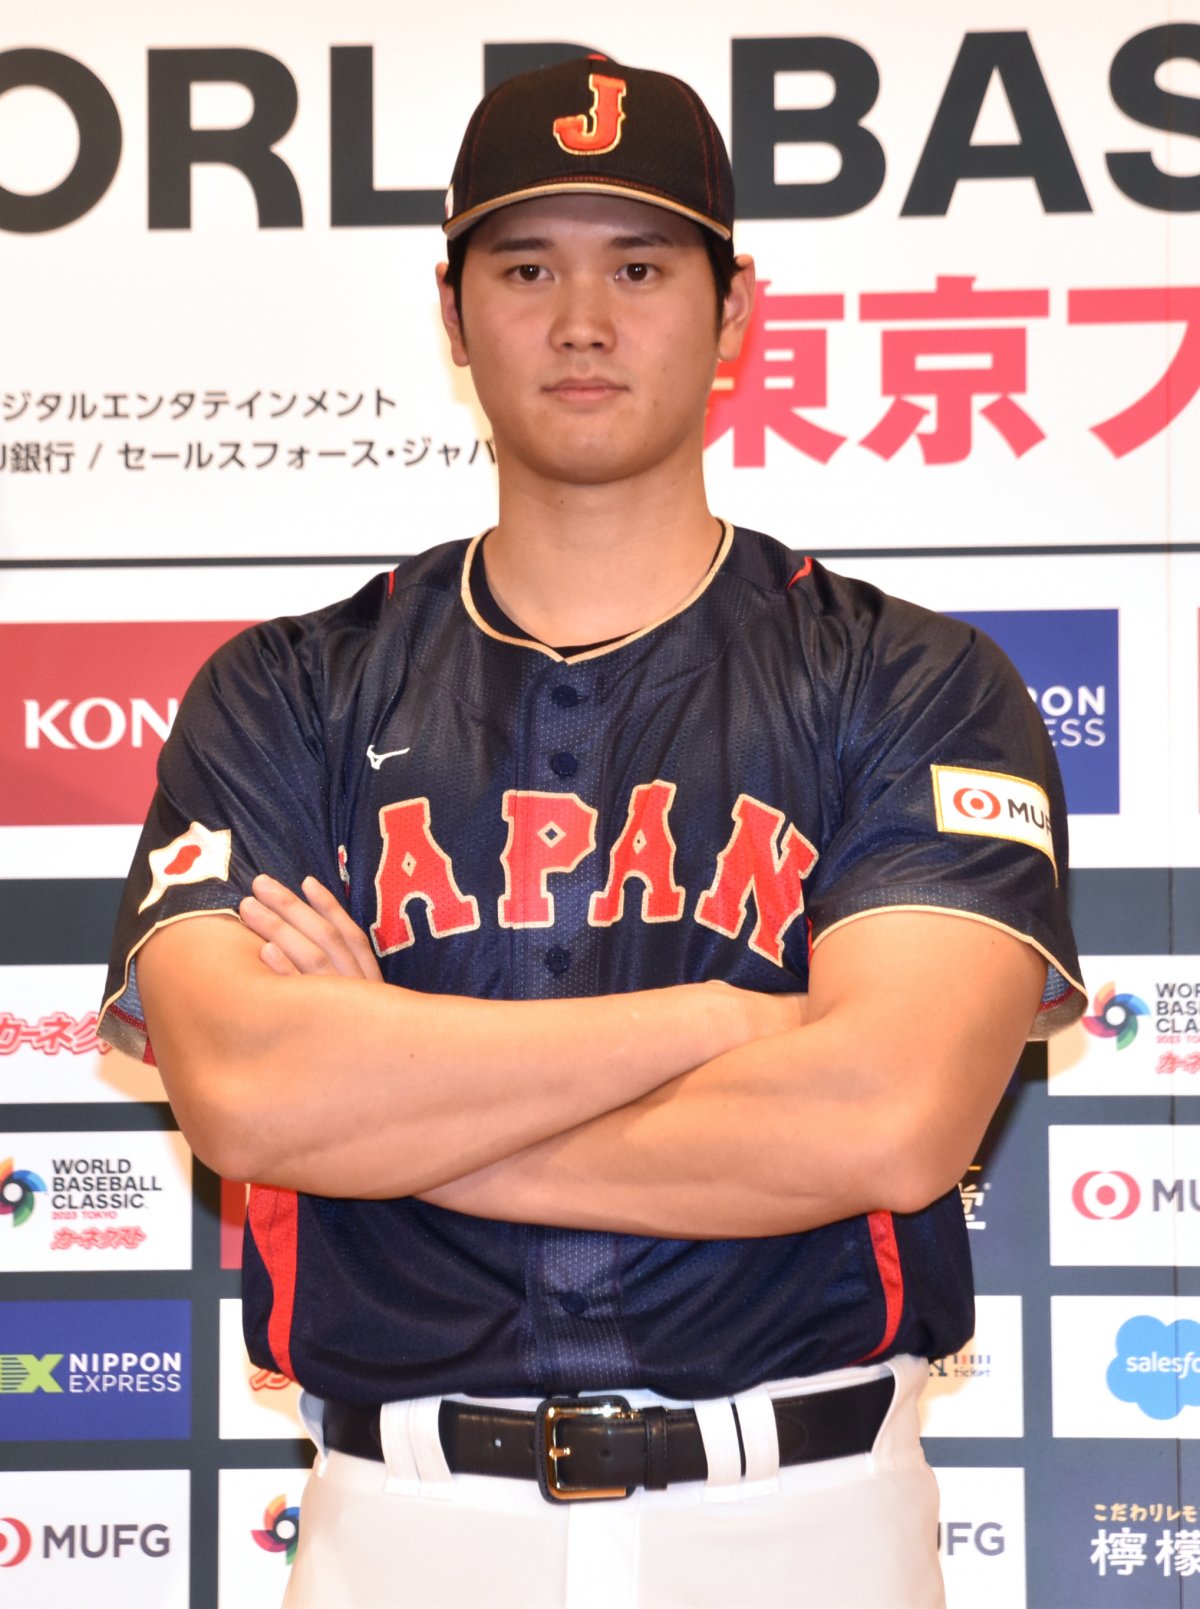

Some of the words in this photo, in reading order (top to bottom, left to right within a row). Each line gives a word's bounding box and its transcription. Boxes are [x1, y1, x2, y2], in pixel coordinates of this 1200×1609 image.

[553, 73, 627, 156] J
[338, 779, 820, 968] APAN
[52, 1159, 132, 1174] WORLD
[52, 1176, 162, 1192] BASEBALL
[52, 1194, 145, 1209] CLASSIC
[69, 1352, 181, 1373] NIPPON
[69, 1373, 181, 1393] EXPRESS
[43, 1524, 170, 1559] MUFG
[937, 1521, 1005, 1556] FG
